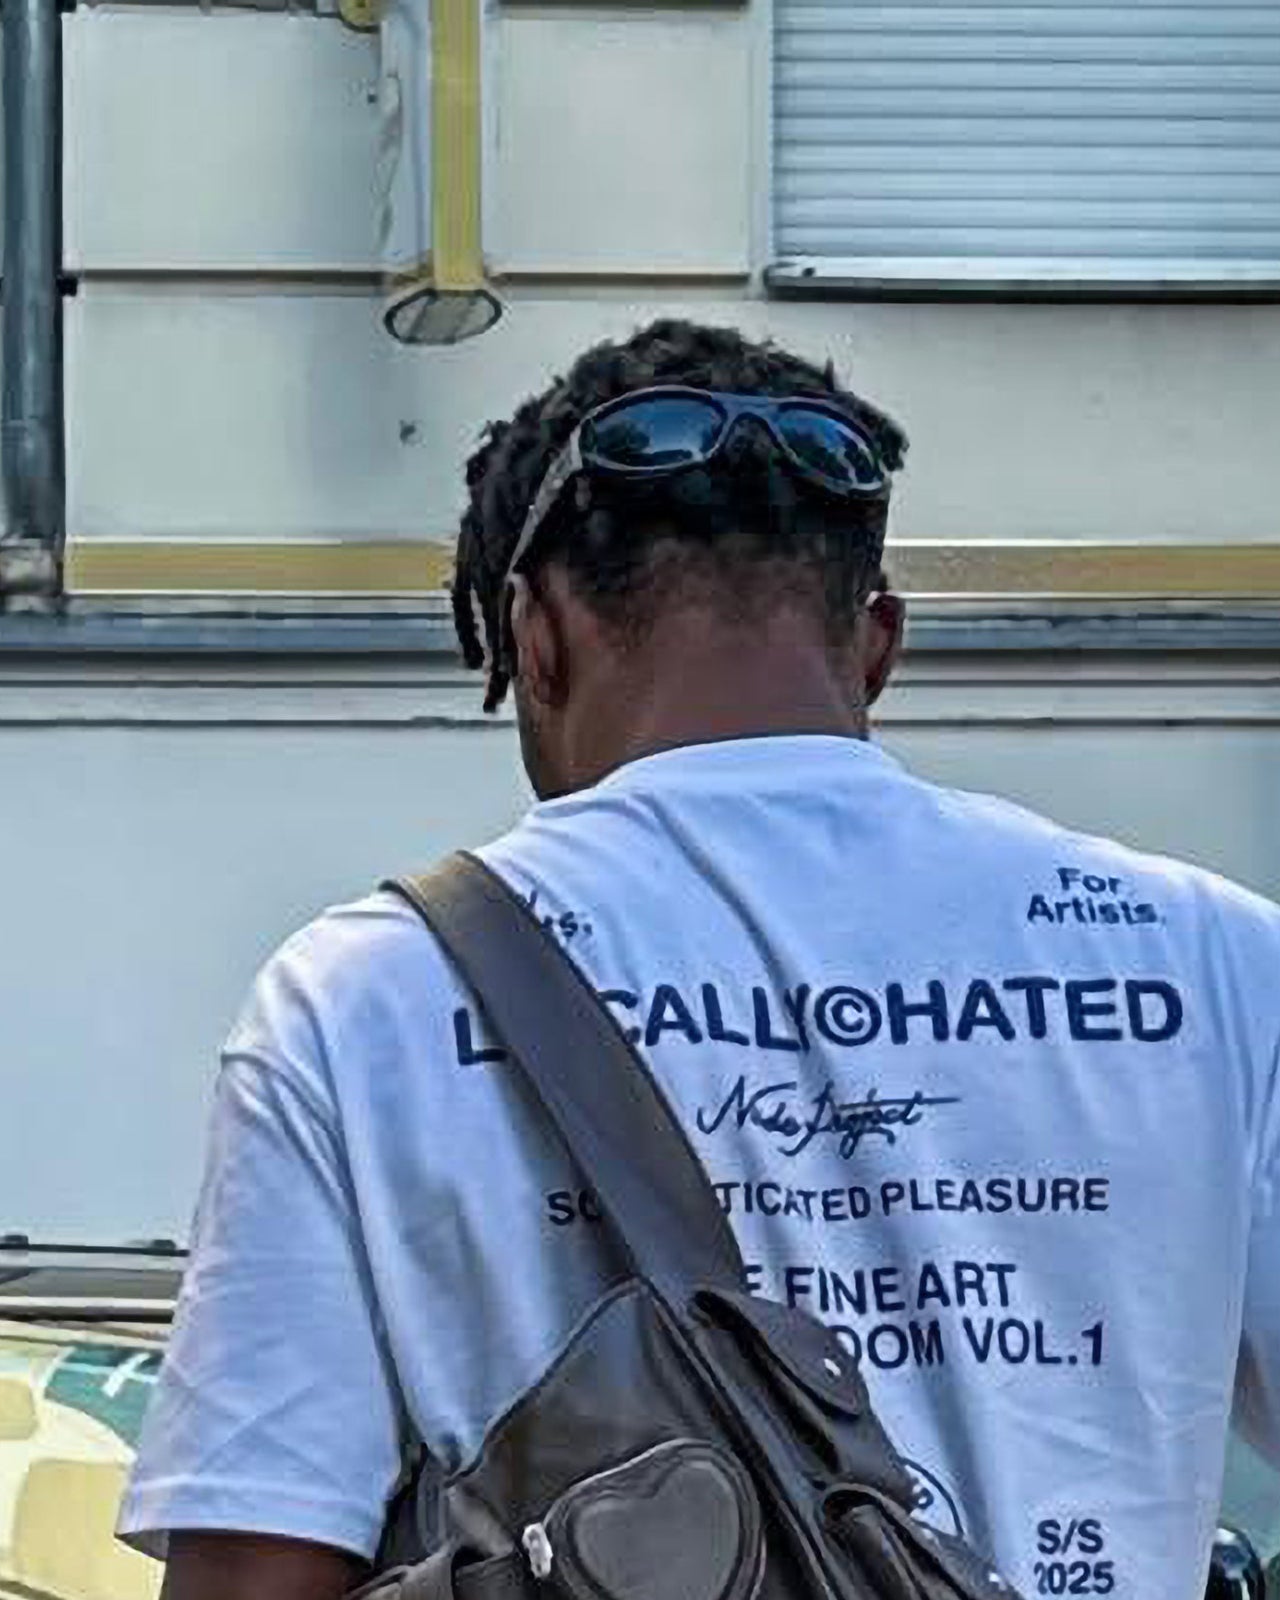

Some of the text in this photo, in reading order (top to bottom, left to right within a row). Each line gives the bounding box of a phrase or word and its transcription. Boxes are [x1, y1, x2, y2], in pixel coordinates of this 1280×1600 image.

[1056, 867, 1122, 894] For
[547, 1177, 1111, 1226] SOTICATED PLEASURE
[784, 1265, 907, 1316] FINE
[916, 1260, 1017, 1308] ART
[962, 1317, 1104, 1367] VOL.1
[1036, 1518, 1104, 1556] S/S
